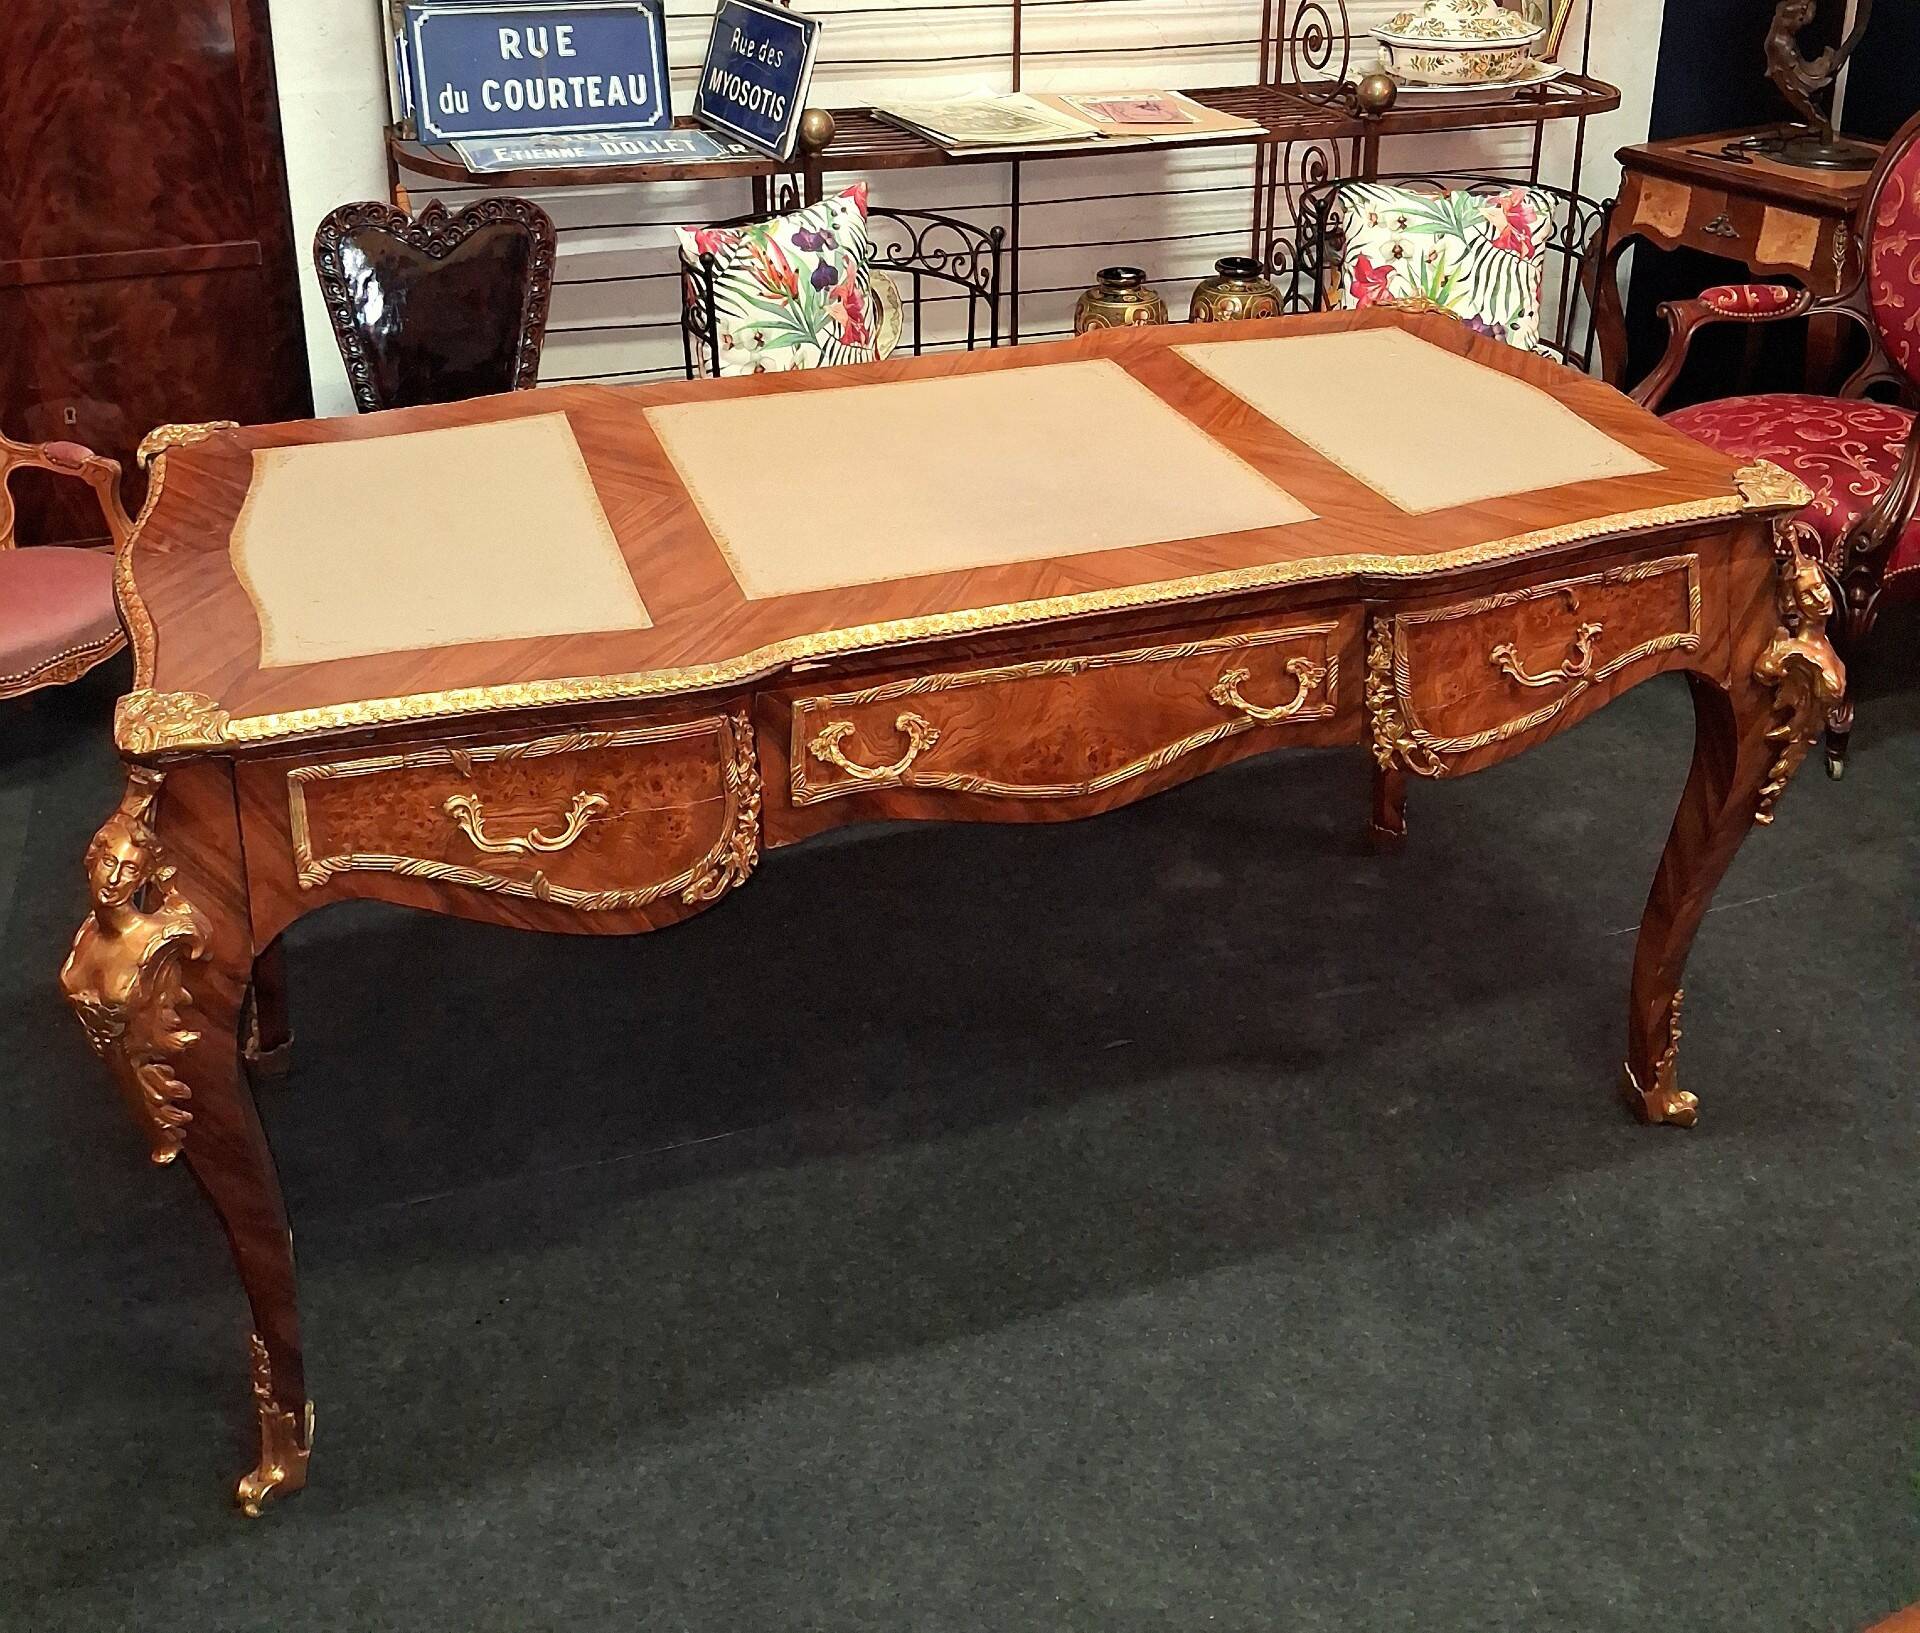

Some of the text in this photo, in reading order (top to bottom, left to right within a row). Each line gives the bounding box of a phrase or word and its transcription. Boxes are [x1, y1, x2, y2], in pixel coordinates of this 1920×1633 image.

[498, 25, 577, 60] RUE
[730, 27, 784, 68] Rue des
[439, 74, 649, 115] du COURTEAU
[708, 67, 786, 122] MYOSOTIS
[600, 139, 698, 156] DOLLET
